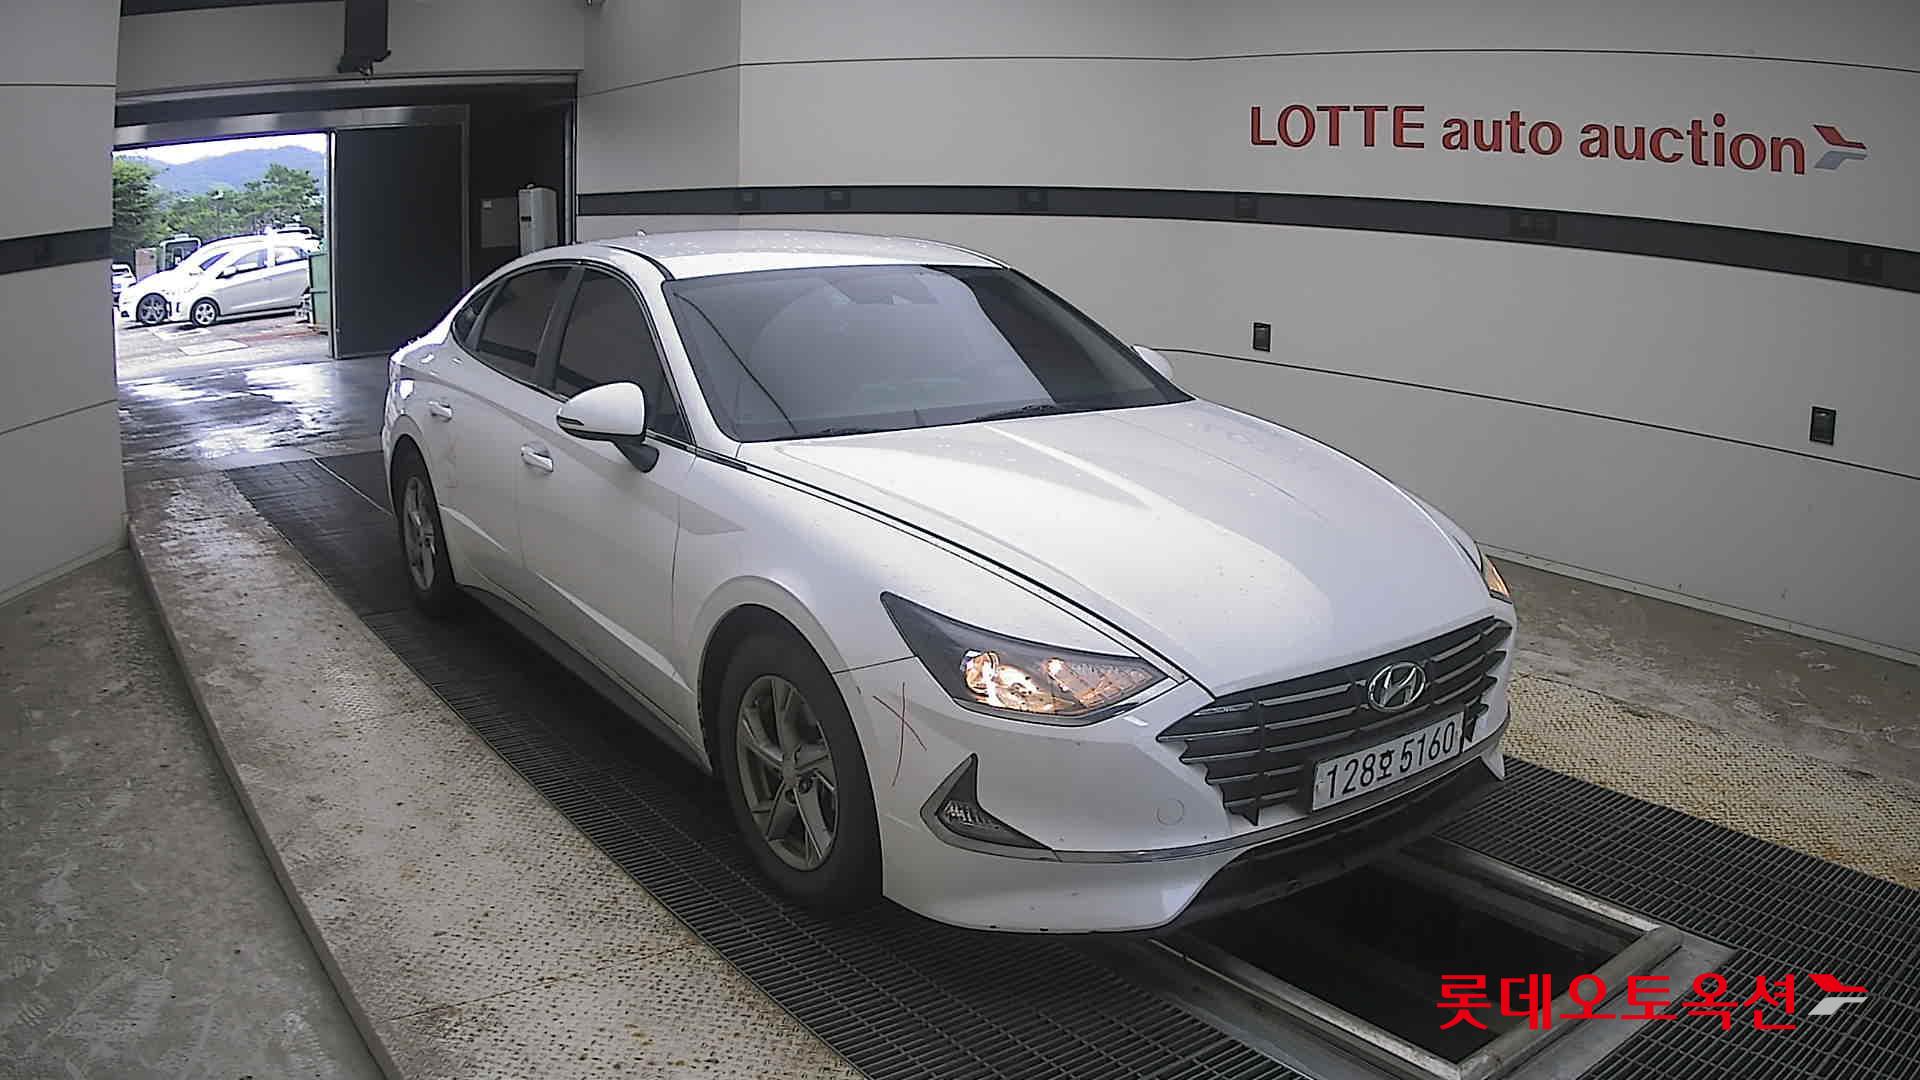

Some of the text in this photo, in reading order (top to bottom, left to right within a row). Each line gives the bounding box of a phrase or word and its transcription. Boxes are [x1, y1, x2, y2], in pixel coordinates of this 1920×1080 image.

[1250, 105, 1806, 175] LOTTE auto auction
